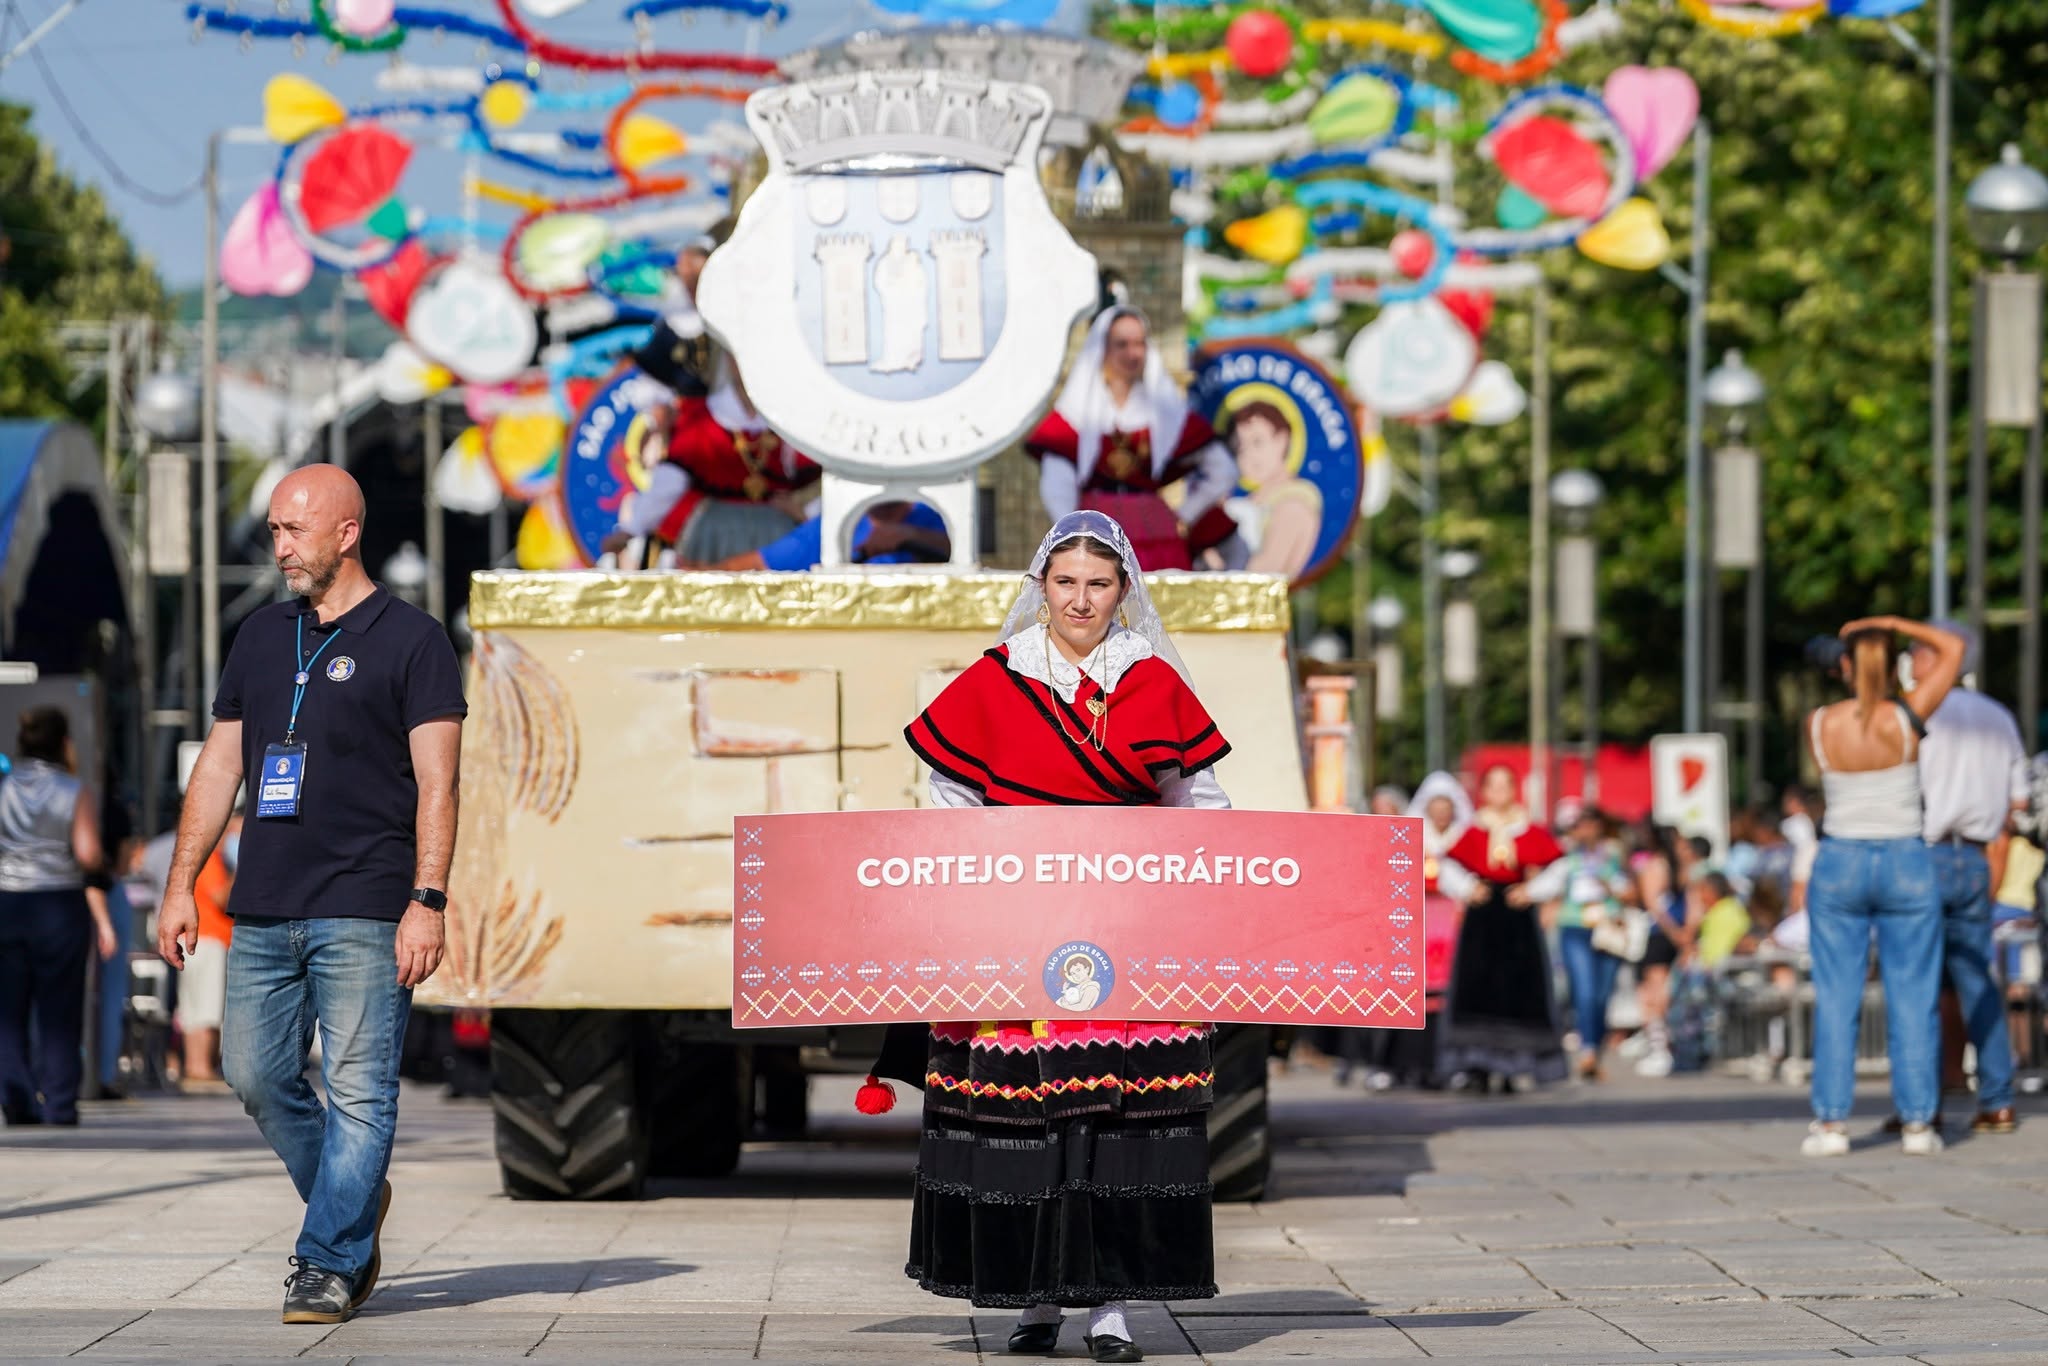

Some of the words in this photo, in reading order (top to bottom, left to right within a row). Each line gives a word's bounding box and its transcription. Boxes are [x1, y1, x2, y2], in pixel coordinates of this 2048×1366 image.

[1258, 354, 1293, 386] DE
[1290, 369, 1348, 451] BRAGA
[820, 408, 984, 456] BRAGA
[856, 854, 1025, 887] CORTEJO
[1034, 846, 1302, 887] ETNOGRÁFICO
[1047, 956, 1059, 971] SÃO
[1058, 945, 1078, 958] JOÃO
[1091, 948, 1109, 971] BRAGA
